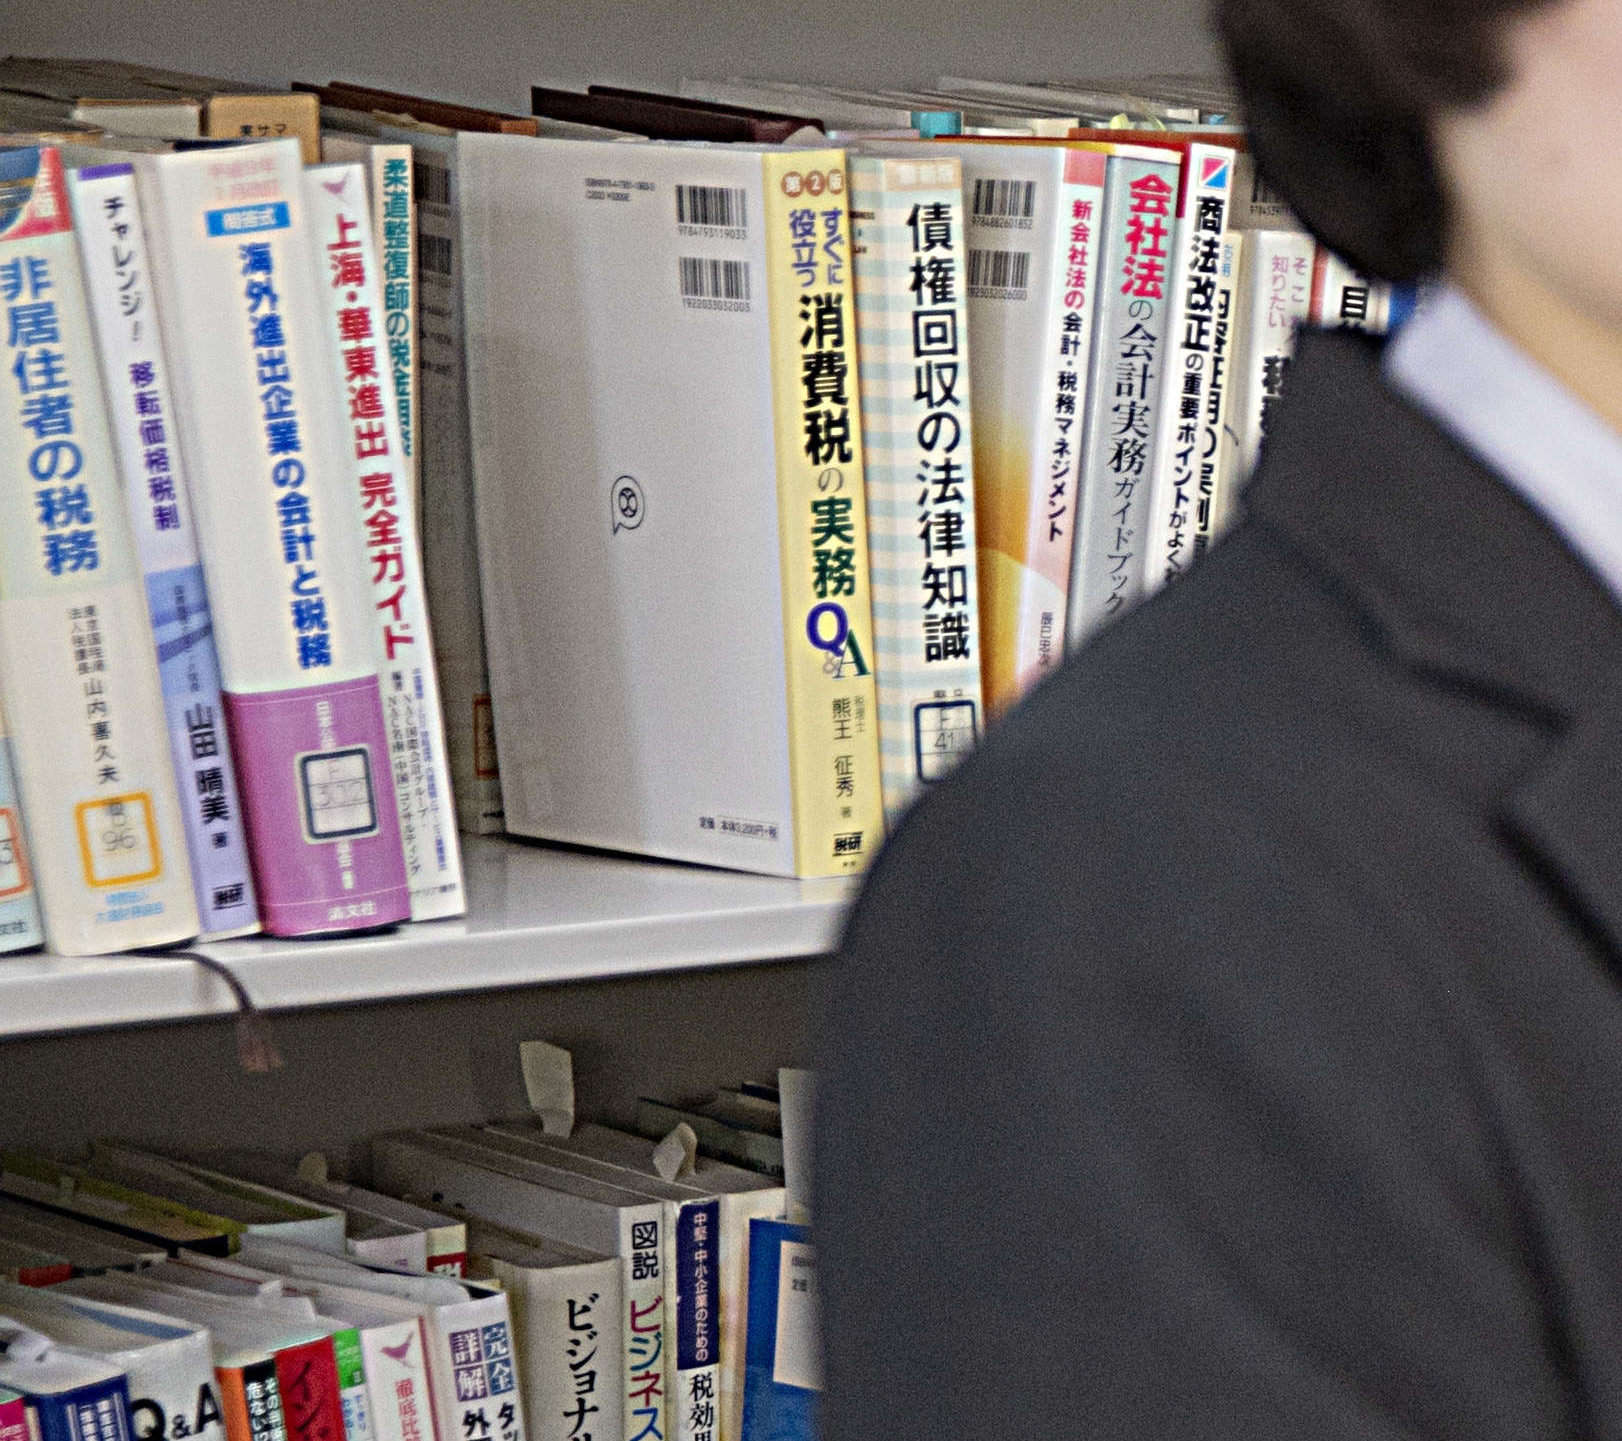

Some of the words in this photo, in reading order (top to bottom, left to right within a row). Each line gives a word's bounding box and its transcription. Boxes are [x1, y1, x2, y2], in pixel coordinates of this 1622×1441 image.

[783, 170, 844, 197] 第2版
[788, 208, 819, 288] 役立つ
[819, 208, 845, 286] すぐに
[102, 195, 146, 345] チャレンジ!
[127, 360, 182, 532] 移転価格税制
[324, 212, 393, 461] 上海・華東進出
[1045, 198, 1094, 545] 新会社法の会計・税務マネジメント
[1103, 172, 1177, 615] 会社法の会計実務ガイドブック
[0, 254, 101, 577] 非居住者の税務
[238, 242, 333, 670] 海外進出企業の会計と税務
[798, 292, 857, 600] 消費税の実務
[905, 201, 972, 665] 債権回収の法律知識
[358, 470, 416, 661] 完全ガイド
[184, 704, 219, 762] 山田
[831, 697, 853, 741] 熊王
[833, 754, 855, 799] 征秀
[630, 1220, 661, 1281] 図説
[691, 1210, 712, 1363] 中堅・中小企業のための
[450, 1331, 488, 1403] 詳解
[482, 1320, 513, 1395] 完全
